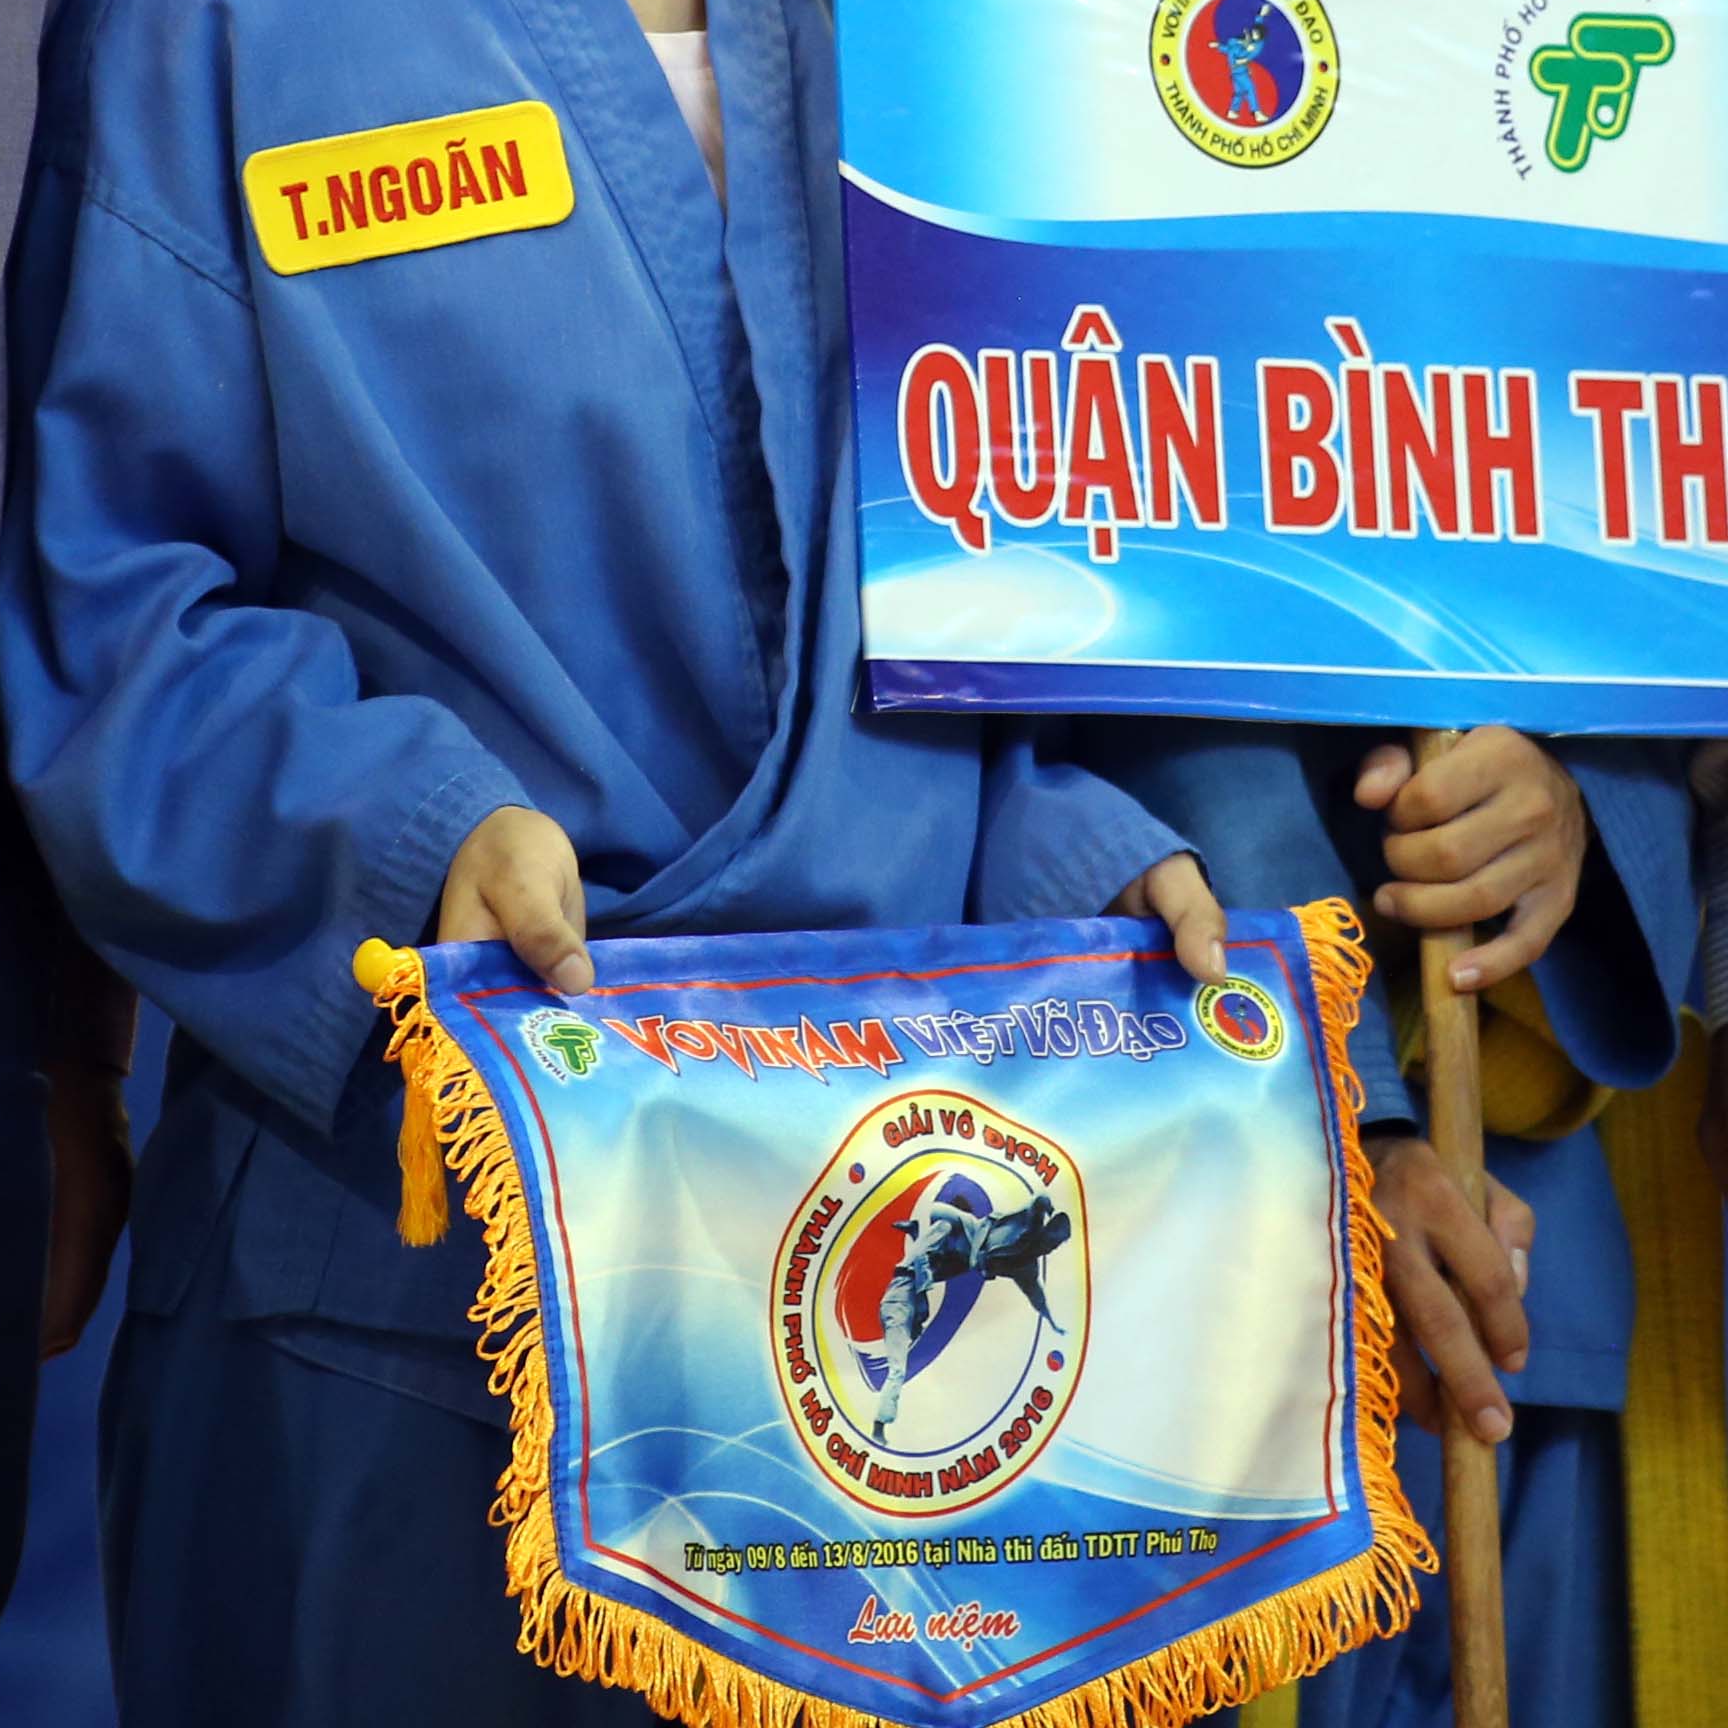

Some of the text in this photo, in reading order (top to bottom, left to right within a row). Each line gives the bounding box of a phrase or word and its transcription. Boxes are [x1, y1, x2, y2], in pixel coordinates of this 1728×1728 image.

[1495, 18, 1522, 79] PHỐ
[1166, 81, 1328, 158] THÀNH PHỐ HỒ CHÍ MINH
[1494, 90, 1533, 180] THÀNH
[280, 137, 528, 241] T.NGOÃN
[902, 307, 1224, 559] QUẬN
[1261, 320, 1541, 541] BÌNH
[600, 1013, 904, 1087] VOVINAM
[1011, 998, 1078, 1057] VÕ
[1077, 1000, 1188, 1061] ĐẠO
[883, 1103, 1059, 1187] GIẢI VÔ ĐỊCH
[783, 1312, 816, 1384] PHỐ
[799, 1388, 834, 1436] HỒ
[998, 1386, 1053, 1457] 2016
[826, 1433, 866, 1480] CHÍ
[866, 1463, 932, 1497] MINH
[938, 1446, 1001, 1493] NĂM
[707, 1544, 743, 1575] ngày
[746, 1544, 786, 1570] 09/8
[790, 1542, 819, 1569] đến
[823, 1541, 918, 1568] 13/8/2016
[924, 1539, 951, 1568] tại
[957, 1539, 997, 1563] Nhà
[1004, 1538, 1033, 1561] thi
[1040, 1533, 1078, 1560] đấu
[1084, 1532, 1139, 1558] TDTT
[1146, 1529, 1183, 1555] Phú
[1189, 1528, 1217, 1555] Thọ
[849, 1594, 1020, 1652] Lưu niệm
